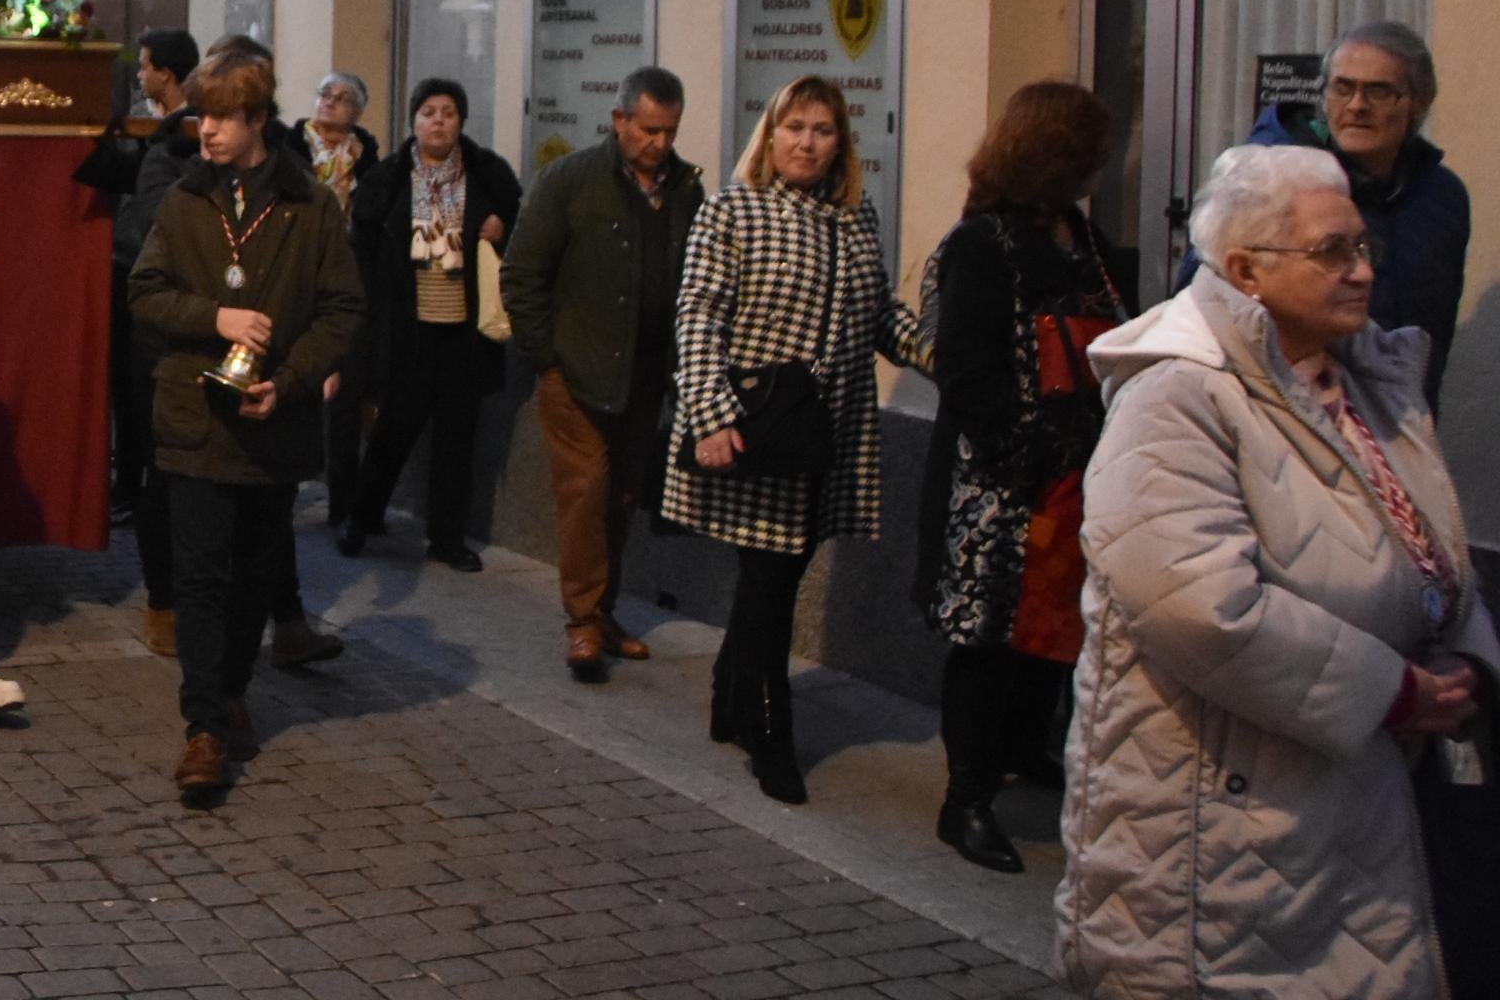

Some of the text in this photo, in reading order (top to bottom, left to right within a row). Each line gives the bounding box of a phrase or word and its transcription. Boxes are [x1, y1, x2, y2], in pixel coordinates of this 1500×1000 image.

[540, 9, 597, 22] ARTESANAL
[752, 22, 823, 36] HOJALDRES
[591, 33, 642, 46] CHAPATAS
[744, 48, 828, 63] MANTECADOS
